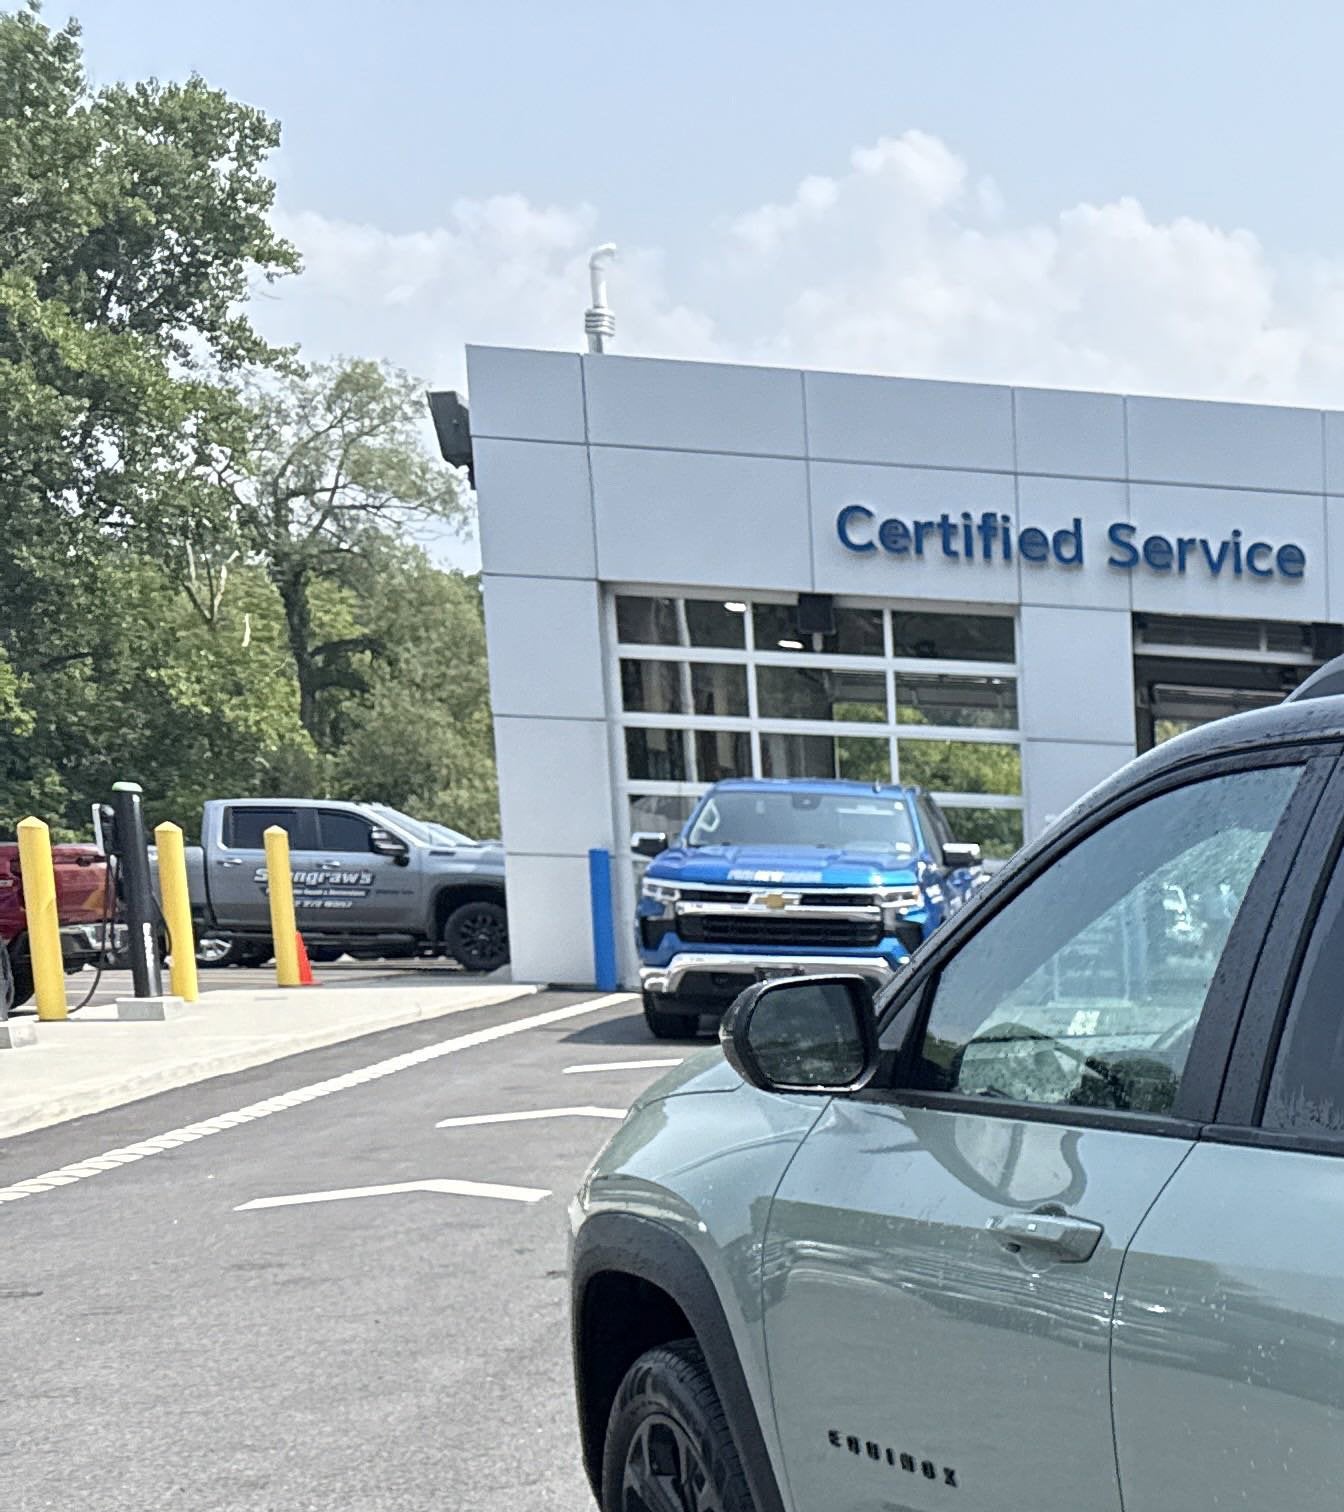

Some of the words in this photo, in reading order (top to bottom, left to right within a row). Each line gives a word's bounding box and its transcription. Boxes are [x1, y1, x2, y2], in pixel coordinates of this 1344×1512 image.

[836, 505, 1085, 567] Certified
[1107, 522, 1307, 579] Service
[254, 868, 374, 885] Sngraw's
[828, 1429, 958, 1488] EQUINOX
